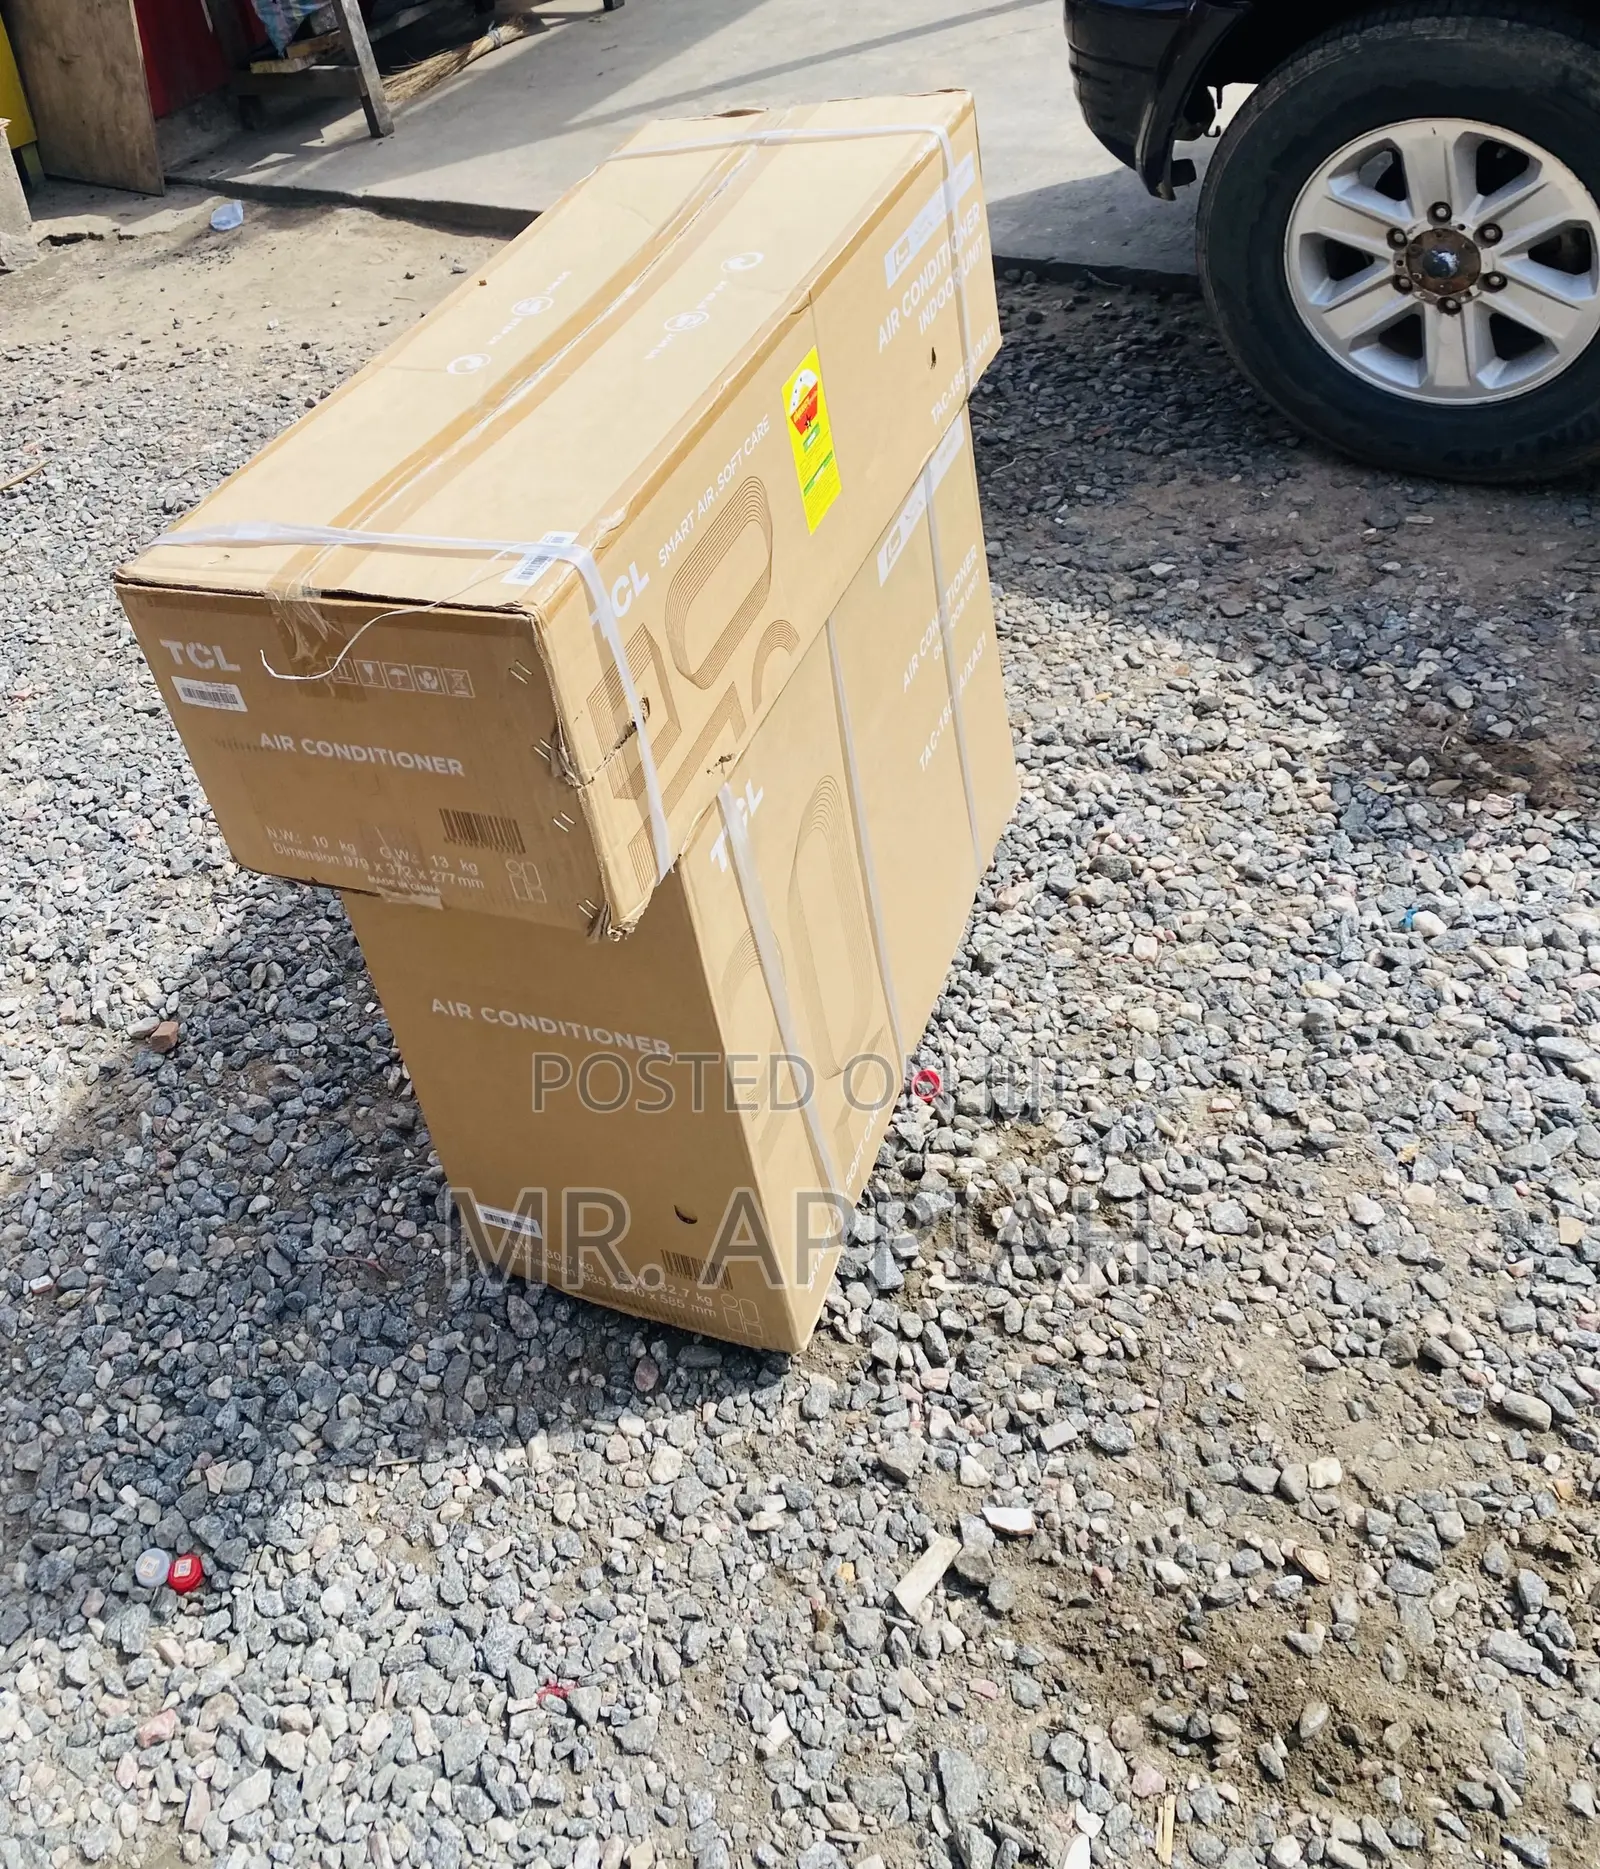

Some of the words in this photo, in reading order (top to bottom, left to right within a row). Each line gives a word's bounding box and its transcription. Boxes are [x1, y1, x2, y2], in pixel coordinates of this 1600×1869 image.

[878, 307, 900, 353] AIR
[903, 202, 980, 317] CONDITIONER
[962, 233, 983, 275] UNIT
[658, 510, 694, 568] SMART
[717, 448, 742, 492] SOFT
[744, 413, 770, 456] CARE
[903, 653, 919, 693] AIR
[919, 544, 978, 658] CONTIONER
[933, 596, 966, 660] OUOOR
[160, 639, 241, 672] TCL
[260, 732, 297, 753] AIR
[301, 737, 466, 777] CONDITIONER
[709, 778, 764, 873] TL
[312, 835, 328, 849] 10
[339, 839, 358, 856] kg
[431, 855, 449, 869] 13
[460, 859, 479, 876] kg
[431, 998, 472, 1020] AIR
[481, 1006, 674, 1057] CONDITIONER
[691, 1304, 717, 1318] mm
[696, 1292, 713, 1307] kg
